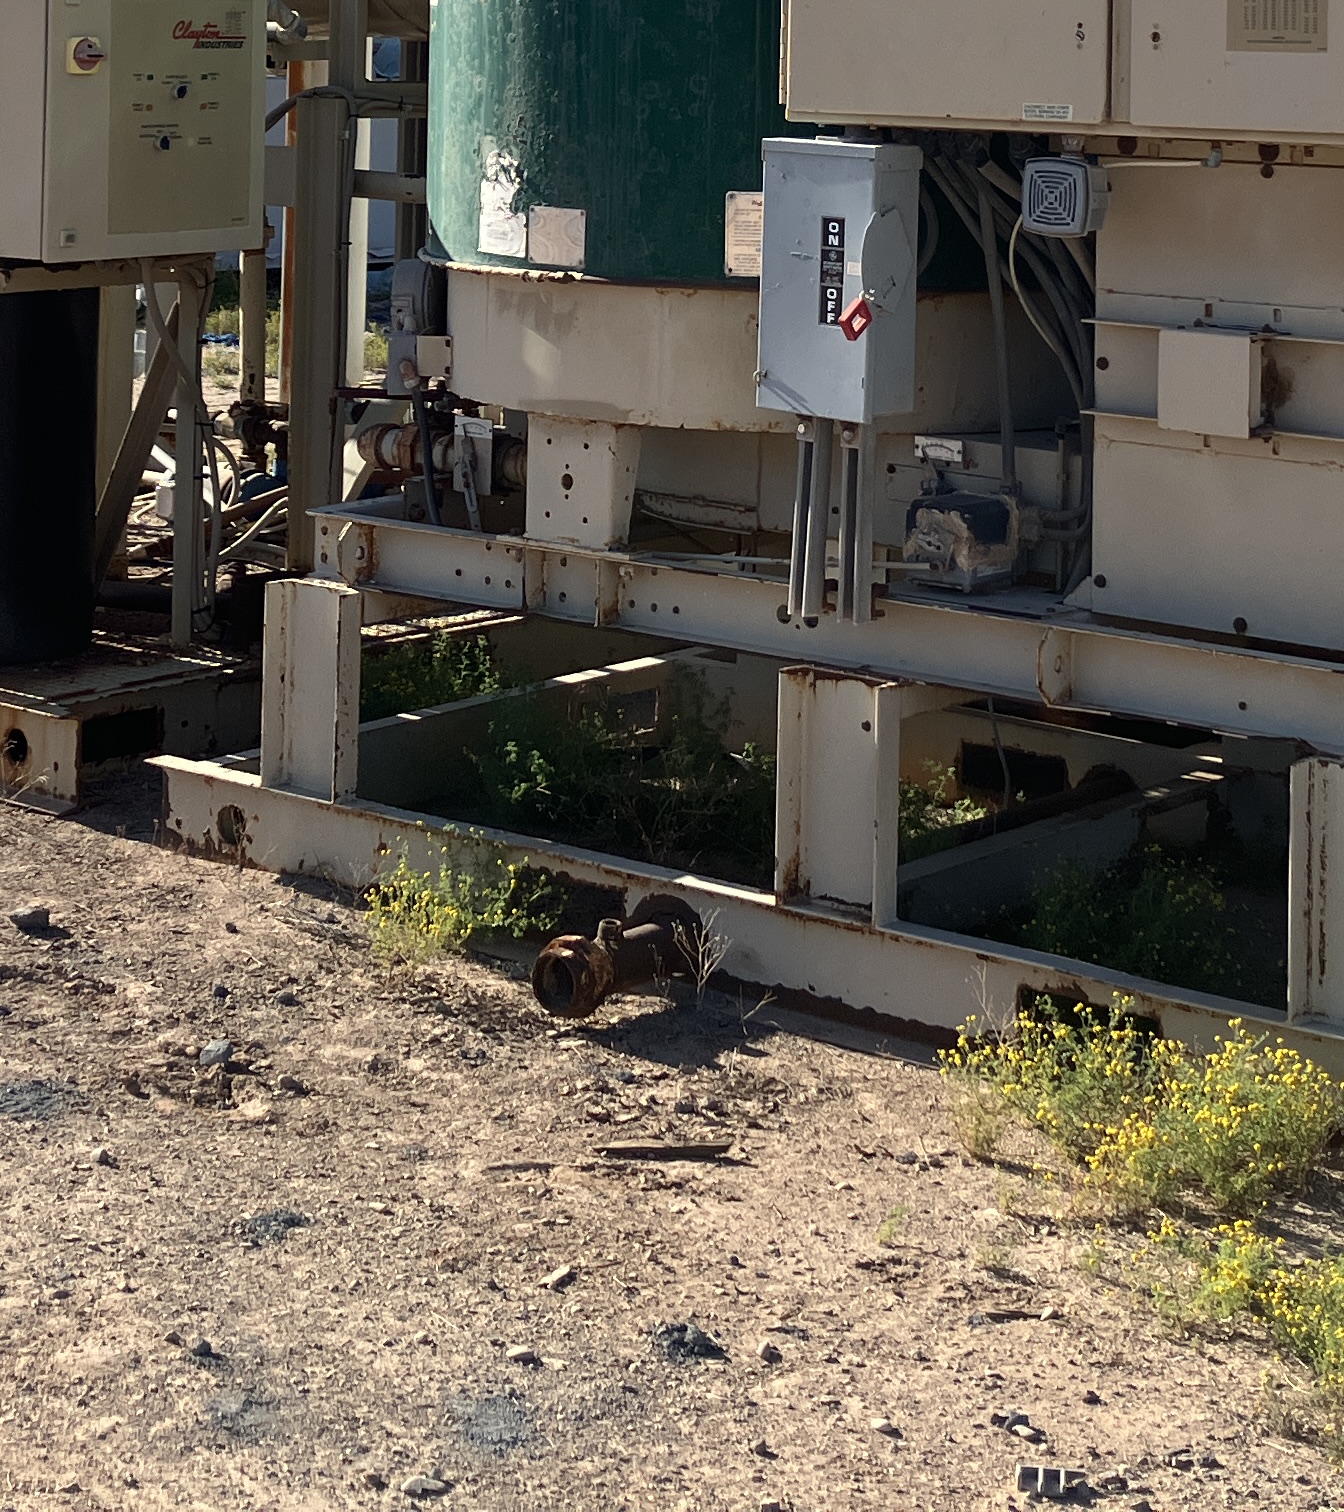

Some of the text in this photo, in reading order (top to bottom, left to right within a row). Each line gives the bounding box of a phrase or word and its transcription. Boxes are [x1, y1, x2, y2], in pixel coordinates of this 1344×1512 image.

[172, 20, 244, 42] Clayton
[193, 41, 244, 49] INDUSTRIES
[828, 222, 839, 246] ON
[826, 288, 837, 324] OFF
